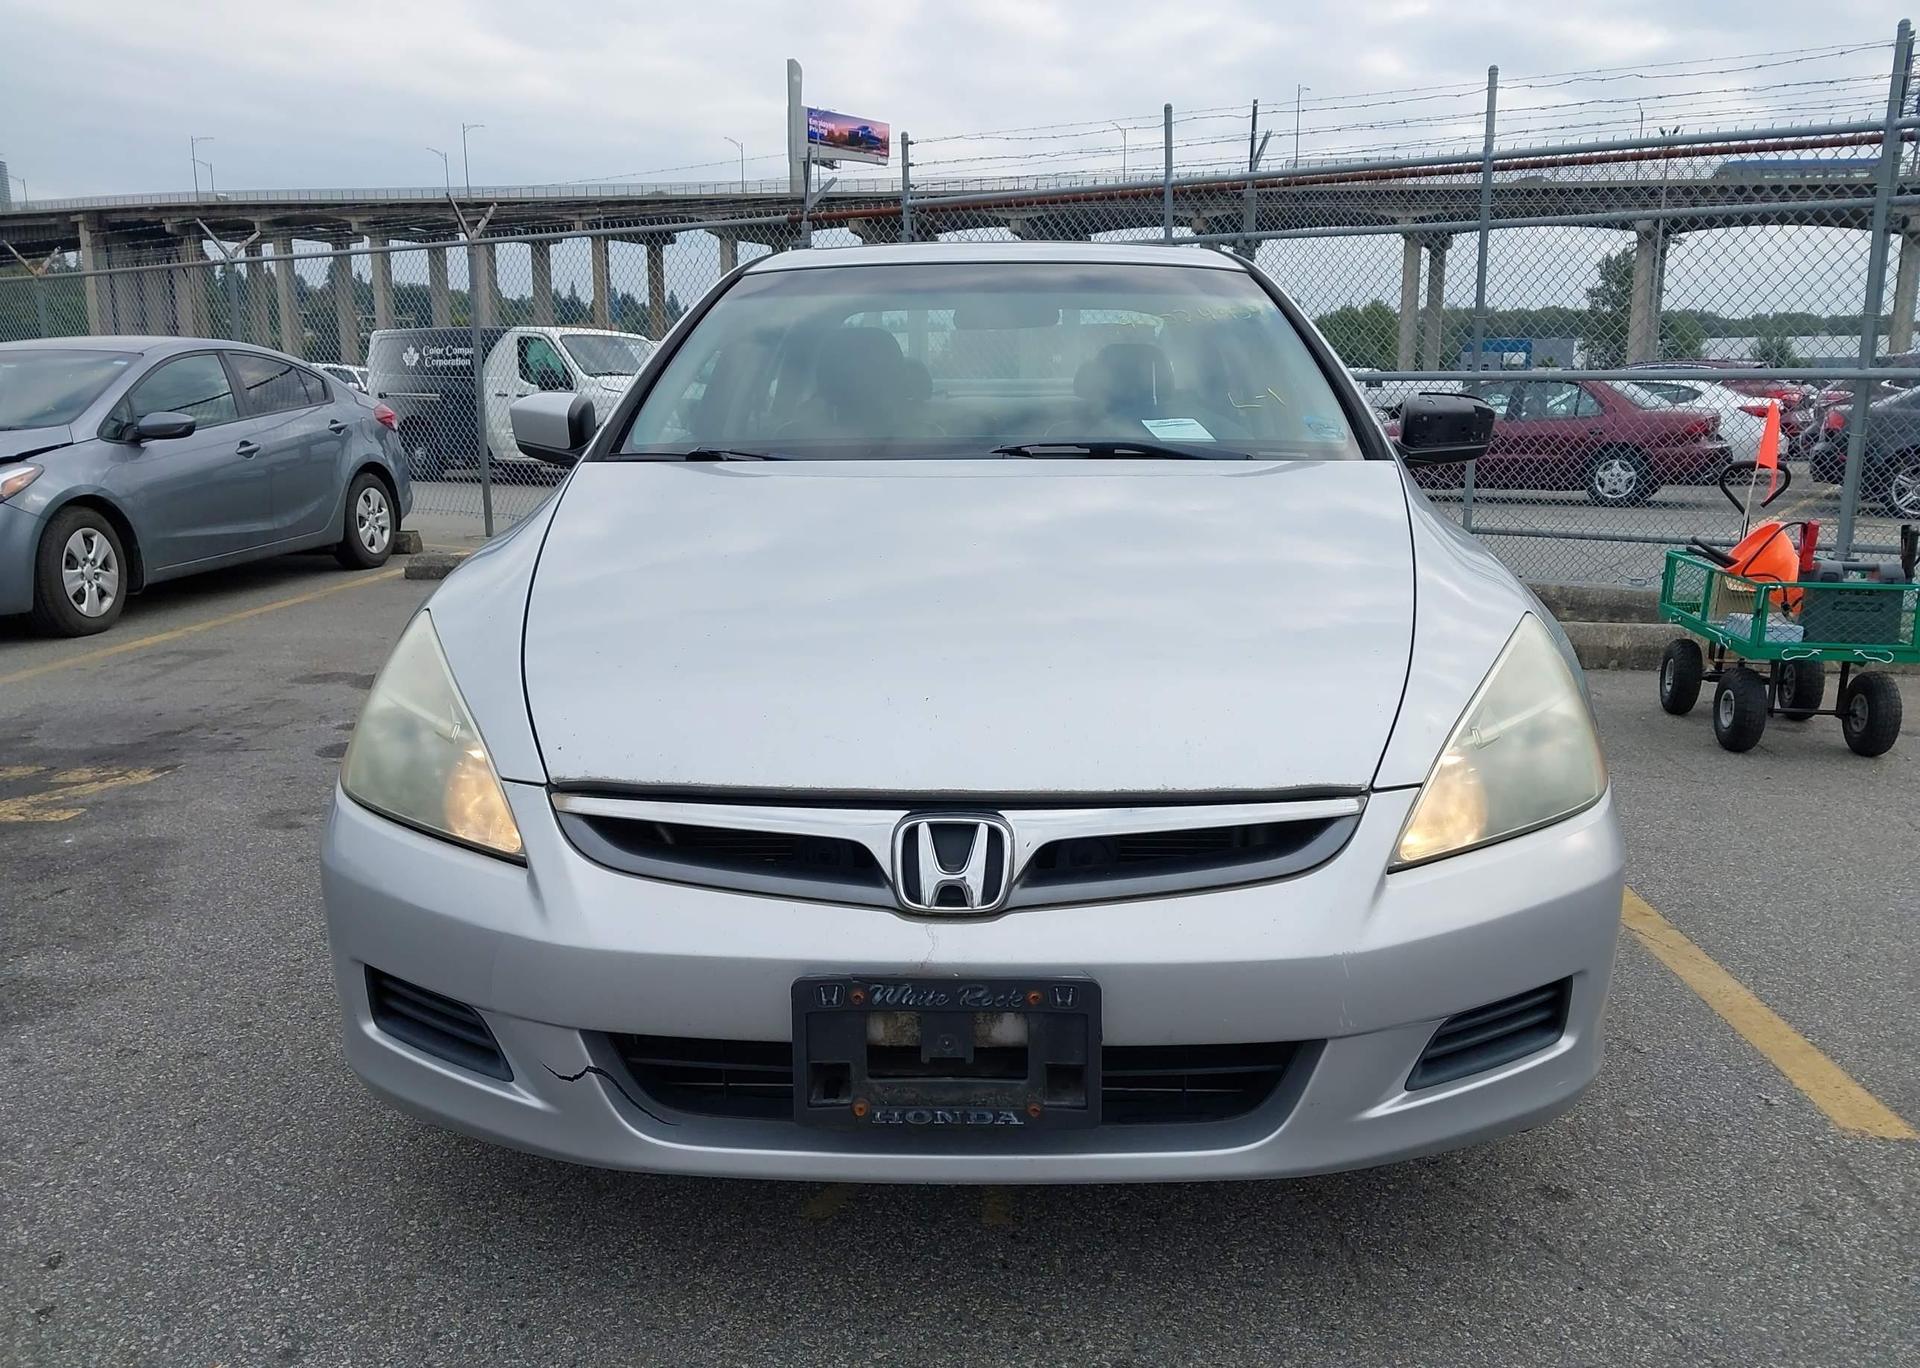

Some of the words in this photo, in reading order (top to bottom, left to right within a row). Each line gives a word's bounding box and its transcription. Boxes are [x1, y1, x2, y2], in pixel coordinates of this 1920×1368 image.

[422, 345, 444, 357] Color
[424, 356, 471, 368] Corporation
[869, 983, 950, 1008] White
[871, 1110, 1025, 1126] HONDA
